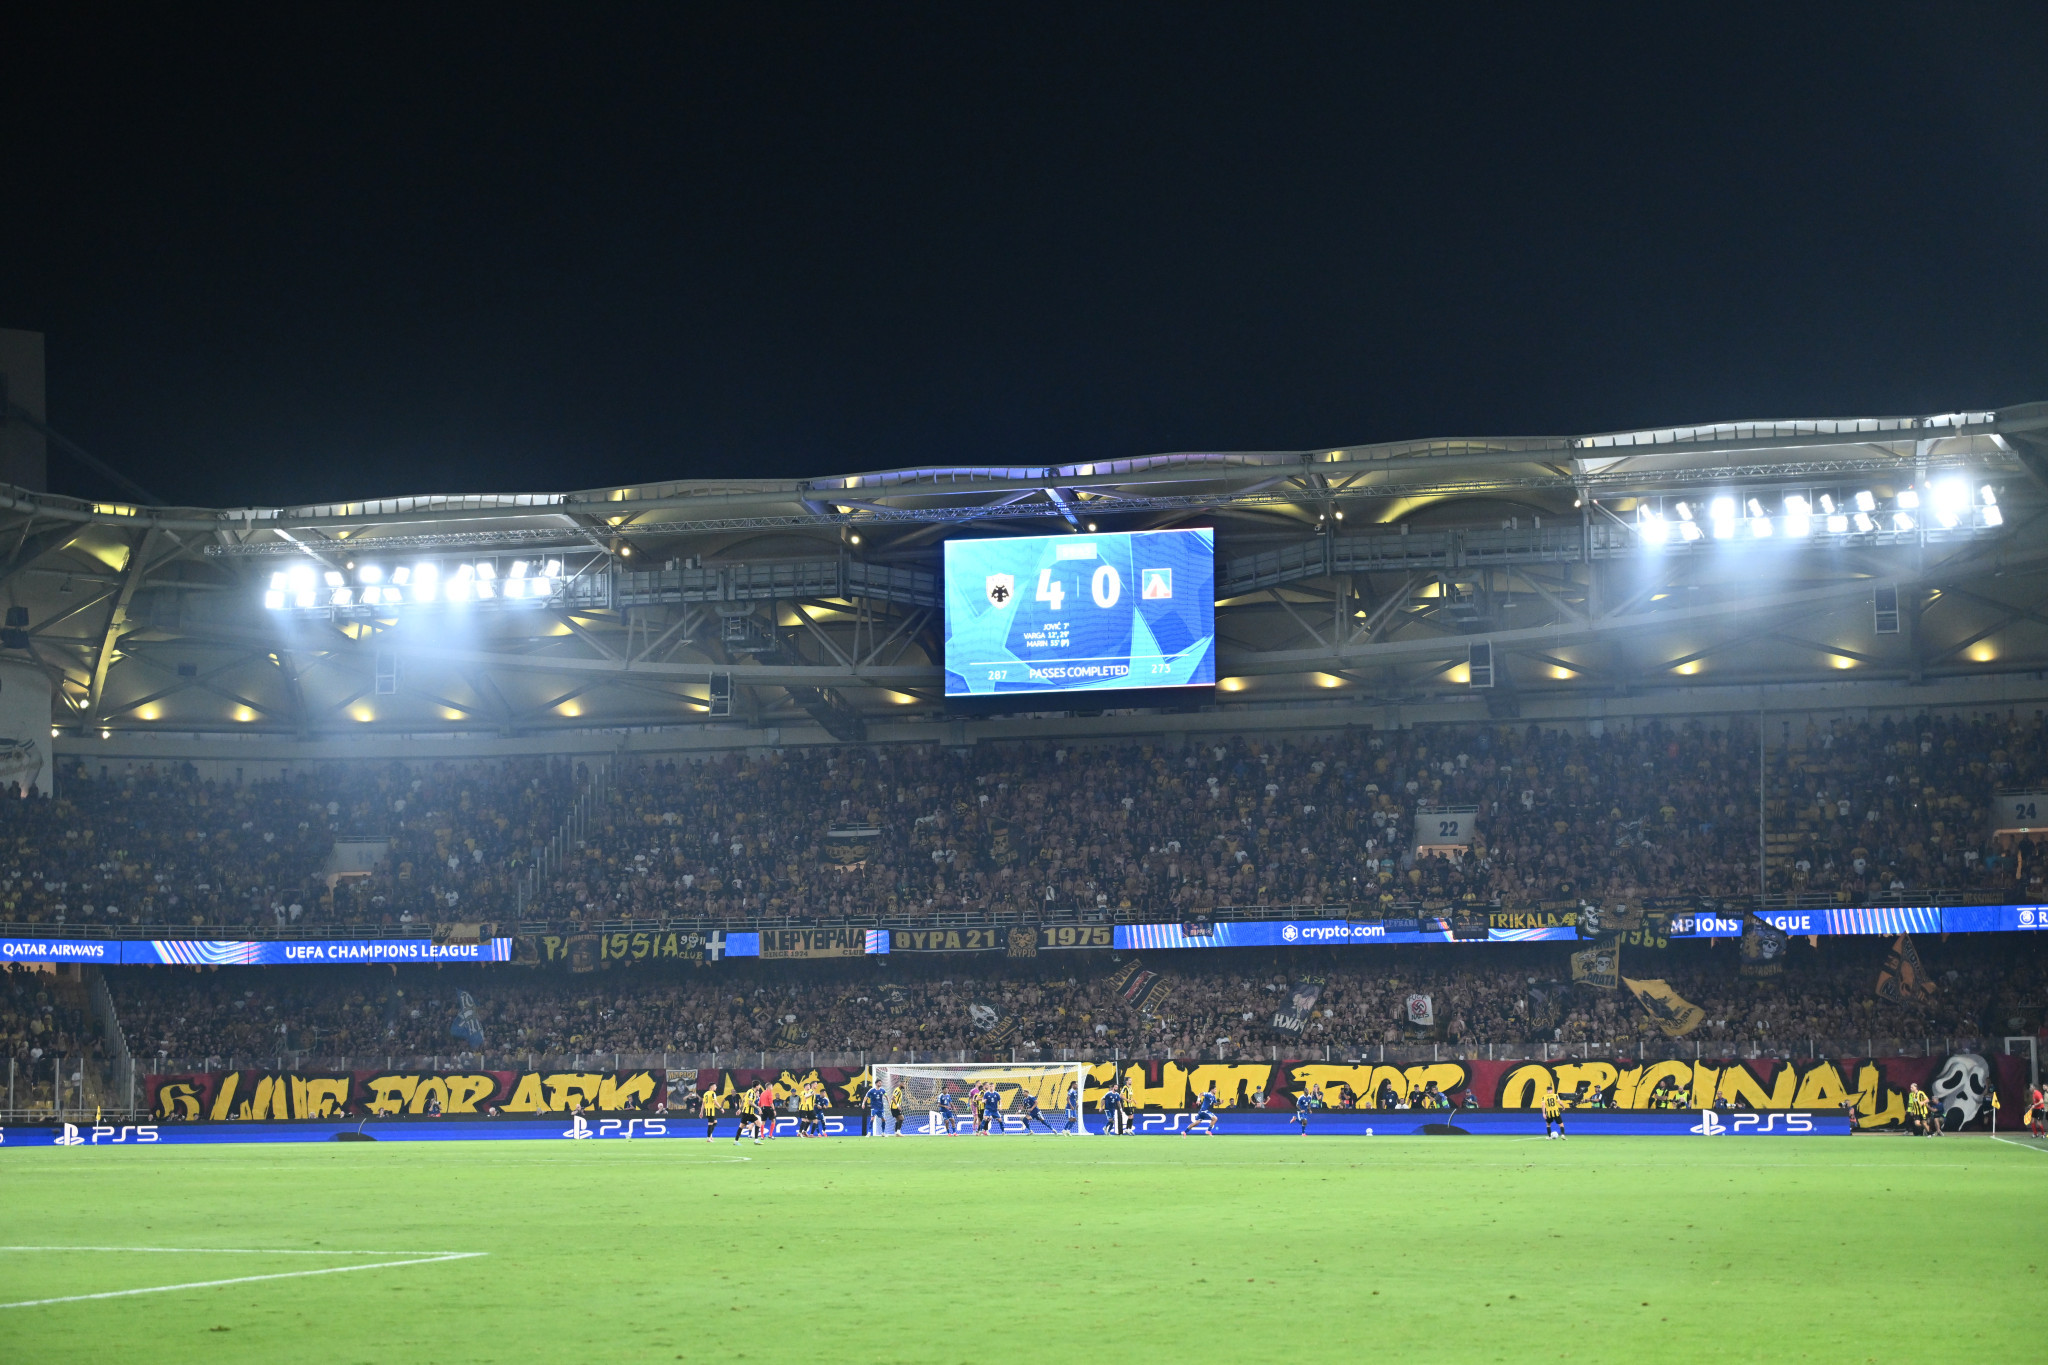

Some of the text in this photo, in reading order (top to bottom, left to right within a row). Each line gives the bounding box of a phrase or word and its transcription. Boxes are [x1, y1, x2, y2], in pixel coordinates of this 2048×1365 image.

[1036, 565, 1121, 610] 4 0
[1023, 632, 1046, 640] VARGA
[1026, 640, 1048, 648] MARIN
[988, 670, 1008, 680] 287
[1029, 667, 1066, 679] PASSES
[1067, 665, 1129, 679] COMPLETED
[2015, 802, 2037, 820] 24
[1439, 821, 1459, 837] 22
[1489, 912, 1557, 929] TRIKALA
[970, 929, 996, 948] 21
[1047, 927, 1111, 947] 1975
[1302, 925, 1386, 940] crypto.com
[2, 943, 104, 957] QATAR AIRWAYS
[285, 944, 479, 959] UEFA CHAMPIONS LEAGUE
[210, 1071, 350, 1121] LIVE
[364, 1074, 496, 1114] FOR
[500, 1071, 657, 1113] AEK
[1289, 1063, 1465, 1110] FOR
[1502, 1060, 1905, 1129] ORIGINAL
[1547, 1097, 1556, 1107] 18
[599, 1118, 667, 1137] PS5
[775, 1115, 844, 1133] P5
[1733, 1113, 1813, 1132] PS5
[92, 1125, 159, 1143] PS5
